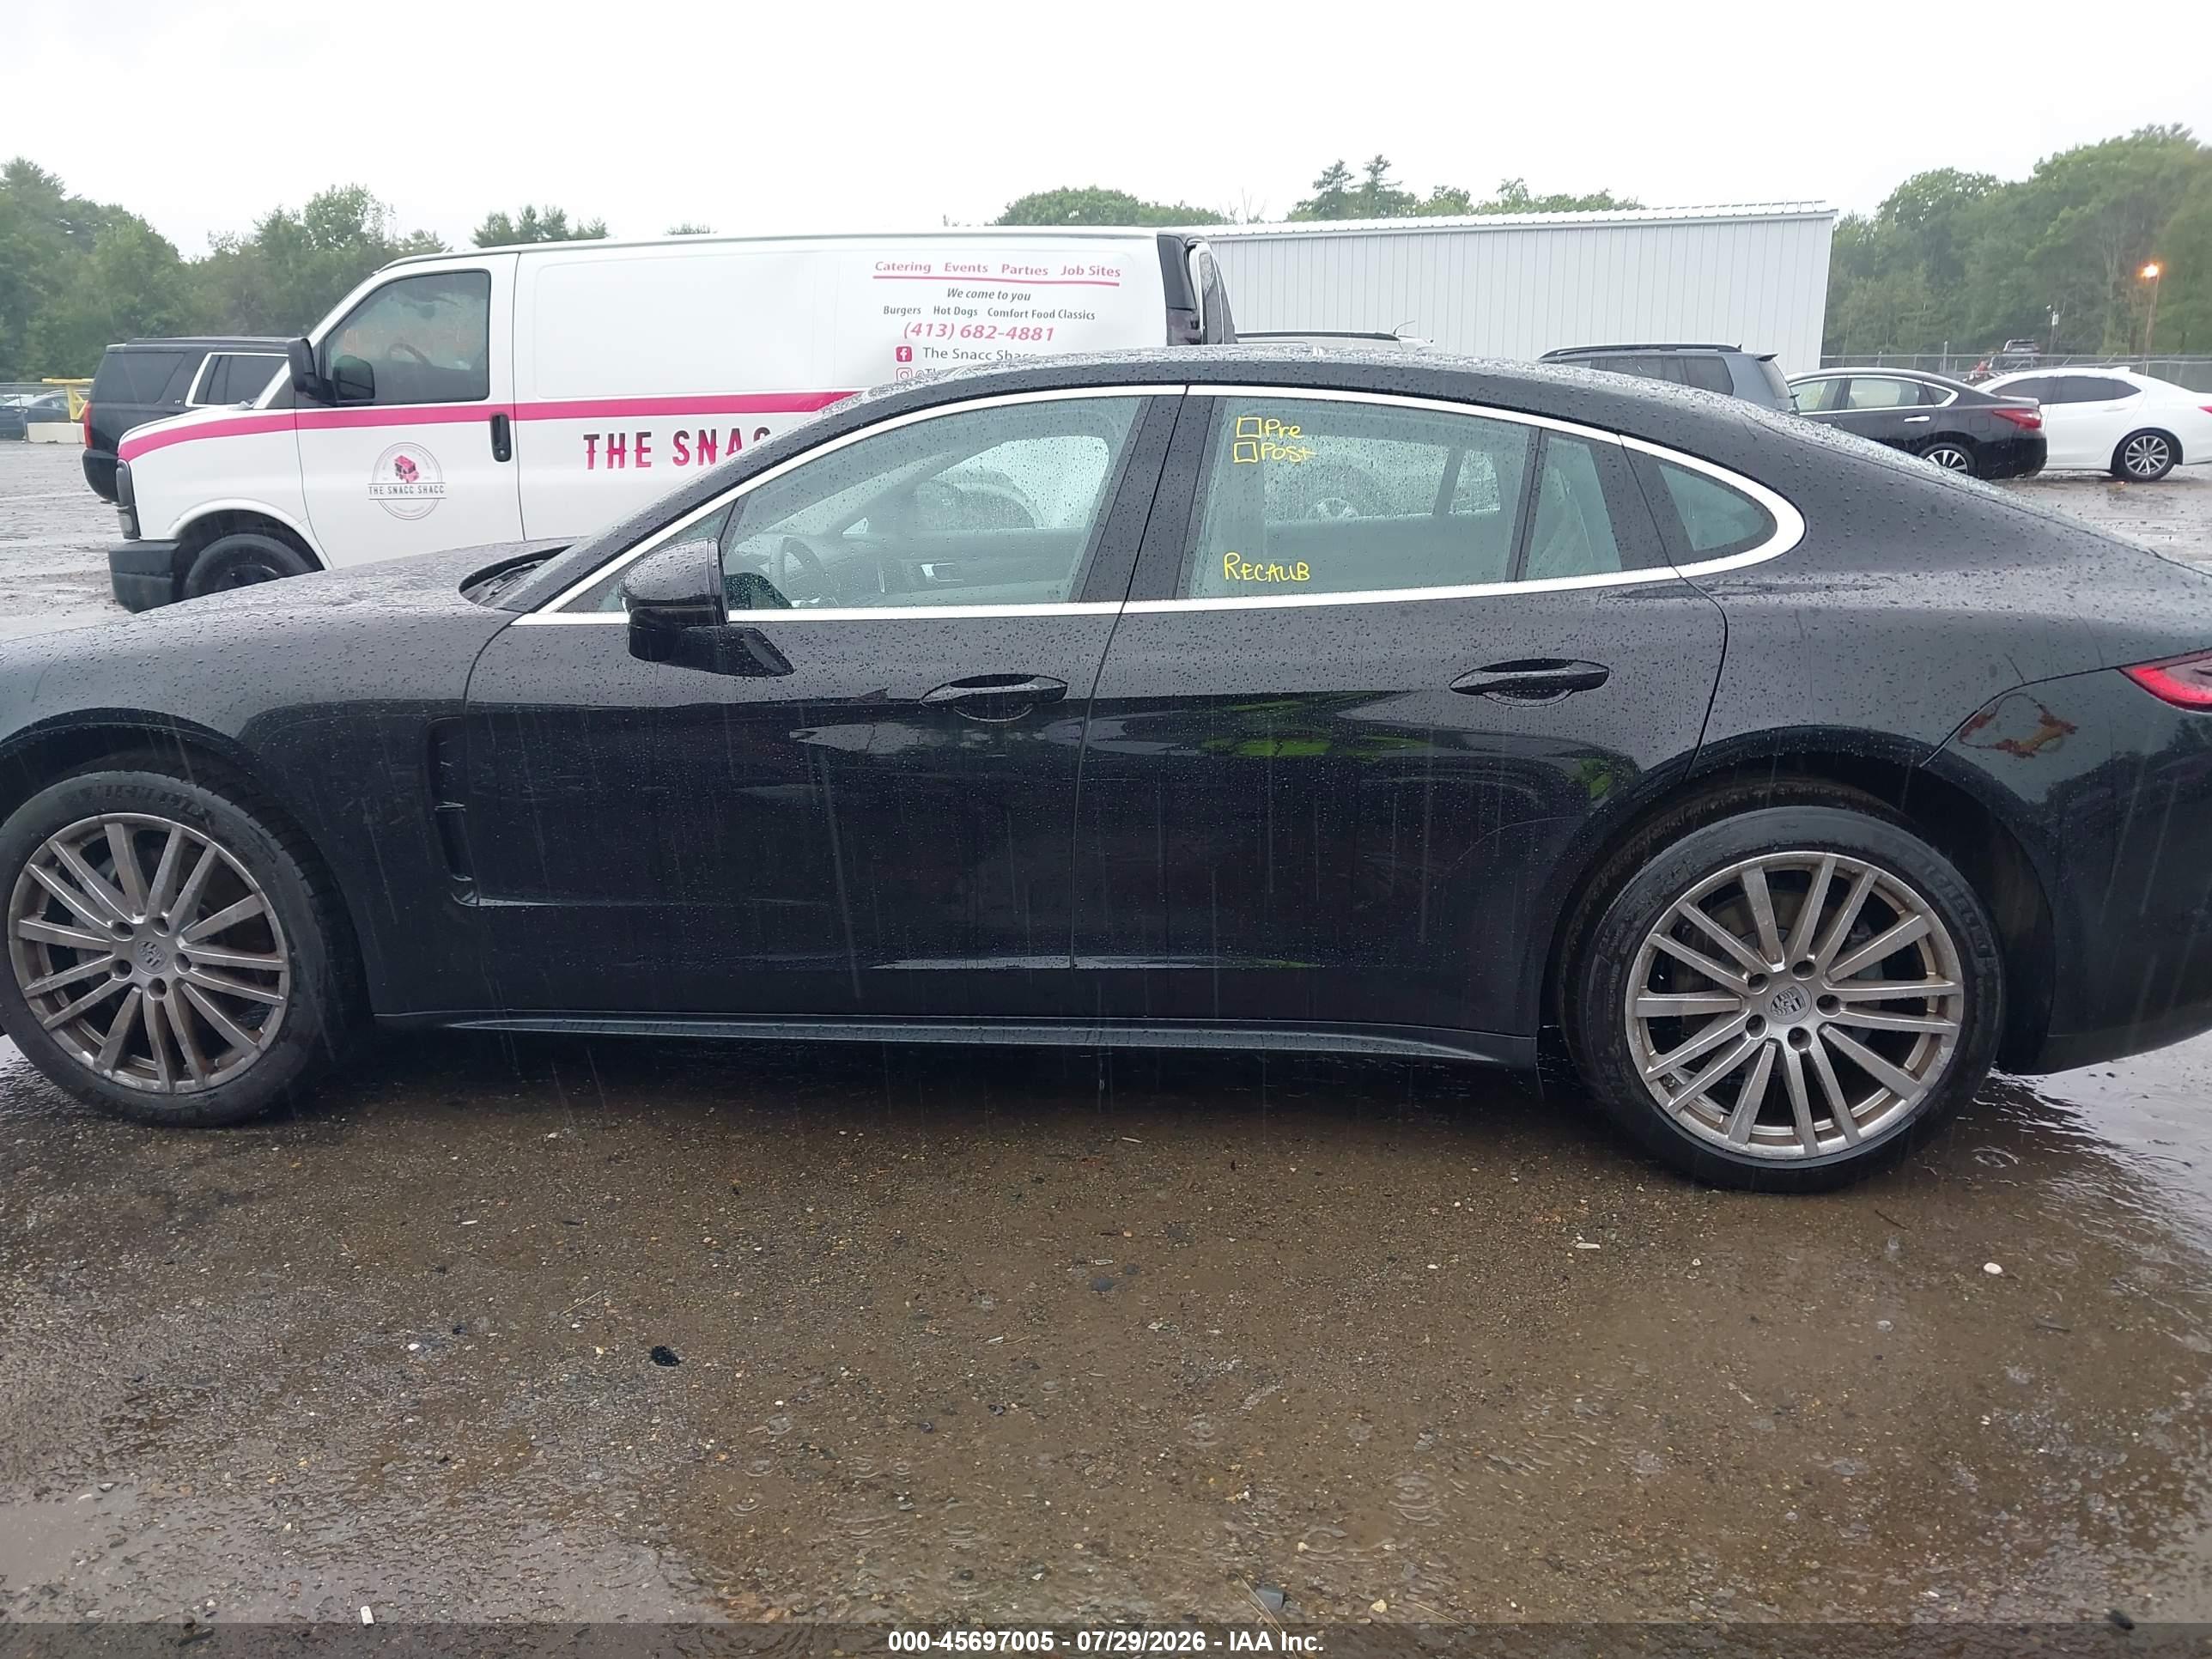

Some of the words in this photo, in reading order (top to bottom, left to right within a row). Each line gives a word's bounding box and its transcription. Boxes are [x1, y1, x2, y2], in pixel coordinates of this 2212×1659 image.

[875, 261, 932, 275] Catering
[944, 262, 989, 273] Events
[1001, 264, 1049, 276] Parties
[1060, 265, 1085, 276] Job
[1088, 265, 1121, 277] Sites
[947, 288, 963, 299] We
[966, 289, 995, 300] come
[997, 290, 1009, 300] to
[1010, 292, 1031, 303] you
[883, 306, 921, 317] Burgers
[933, 306, 951, 315] Hot
[954, 306, 978, 318] Dogs
[987, 307, 1029, 319] Comfort
[1031, 309, 1055, 319] Food
[1058, 308, 1096, 320] Classics
[903, 321, 955, 340] (413)
[960, 325, 1054, 342] 682-4881
[923, 347, 949, 359] The
[952, 349, 993, 361] Snacc
[1264, 418, 1305, 439] Pre
[583, 431, 653, 470] THE
[1260, 442, 1319, 462] Post
[368, 486, 384, 495] THE
[387, 485, 414, 495] SNACC
[417, 484, 445, 494] SHACC
